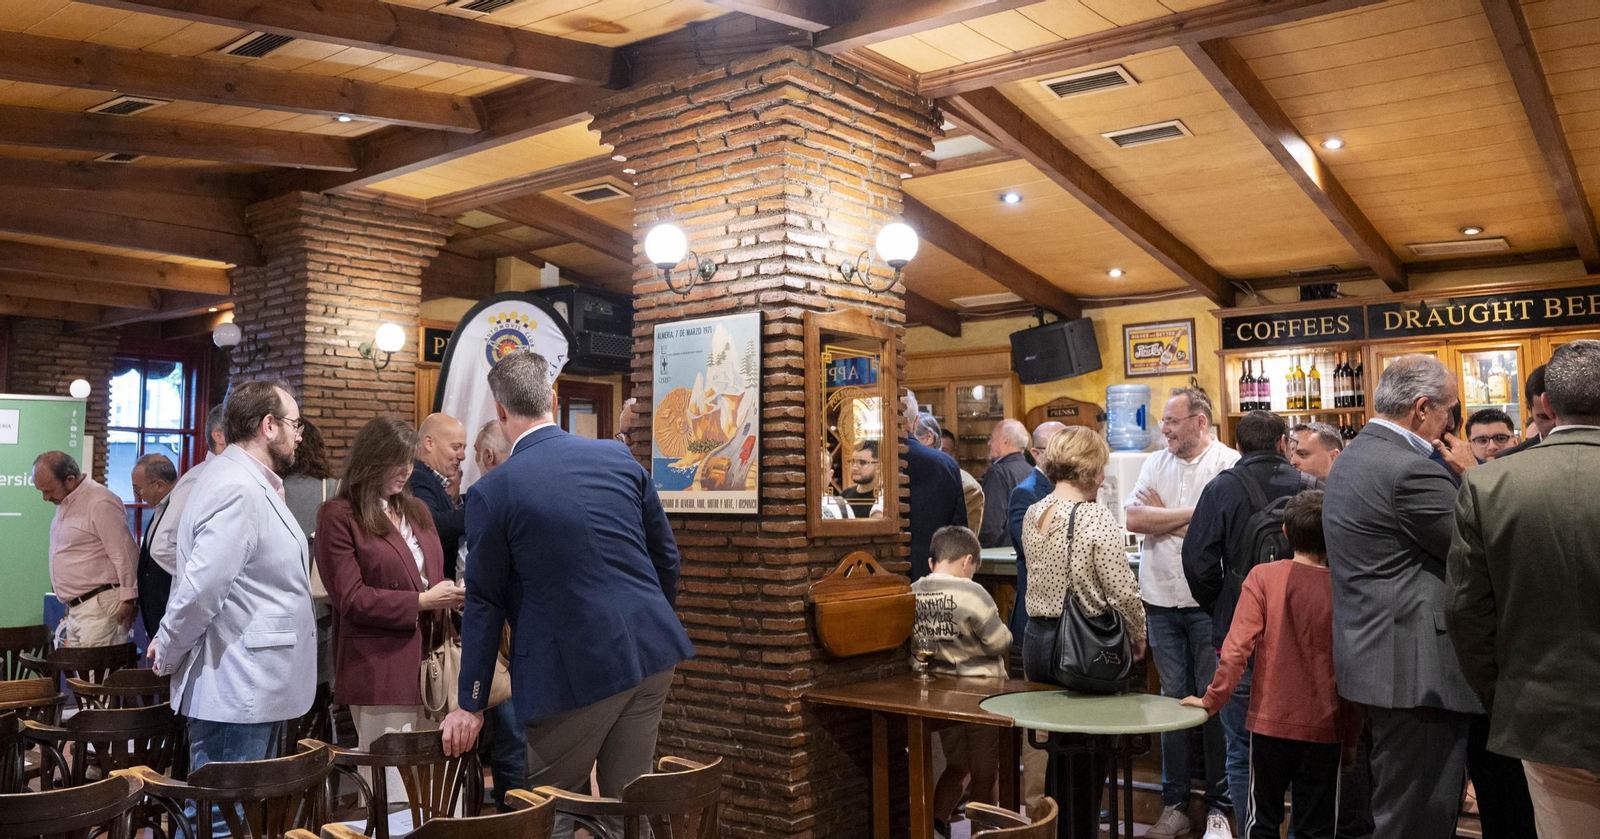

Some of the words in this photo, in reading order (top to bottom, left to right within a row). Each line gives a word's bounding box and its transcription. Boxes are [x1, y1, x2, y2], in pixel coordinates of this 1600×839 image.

[1384, 299, 1533, 331] DRAUGHT
[680, 329, 685, 338] DE
[686, 327, 702, 337] MARZO
[1236, 314, 1350, 342] COFFEES
[1130, 332, 1149, 340] BIGGER
[1155, 330, 1176, 338] BETTER
[1050, 409, 1076, 417] PRENSA
